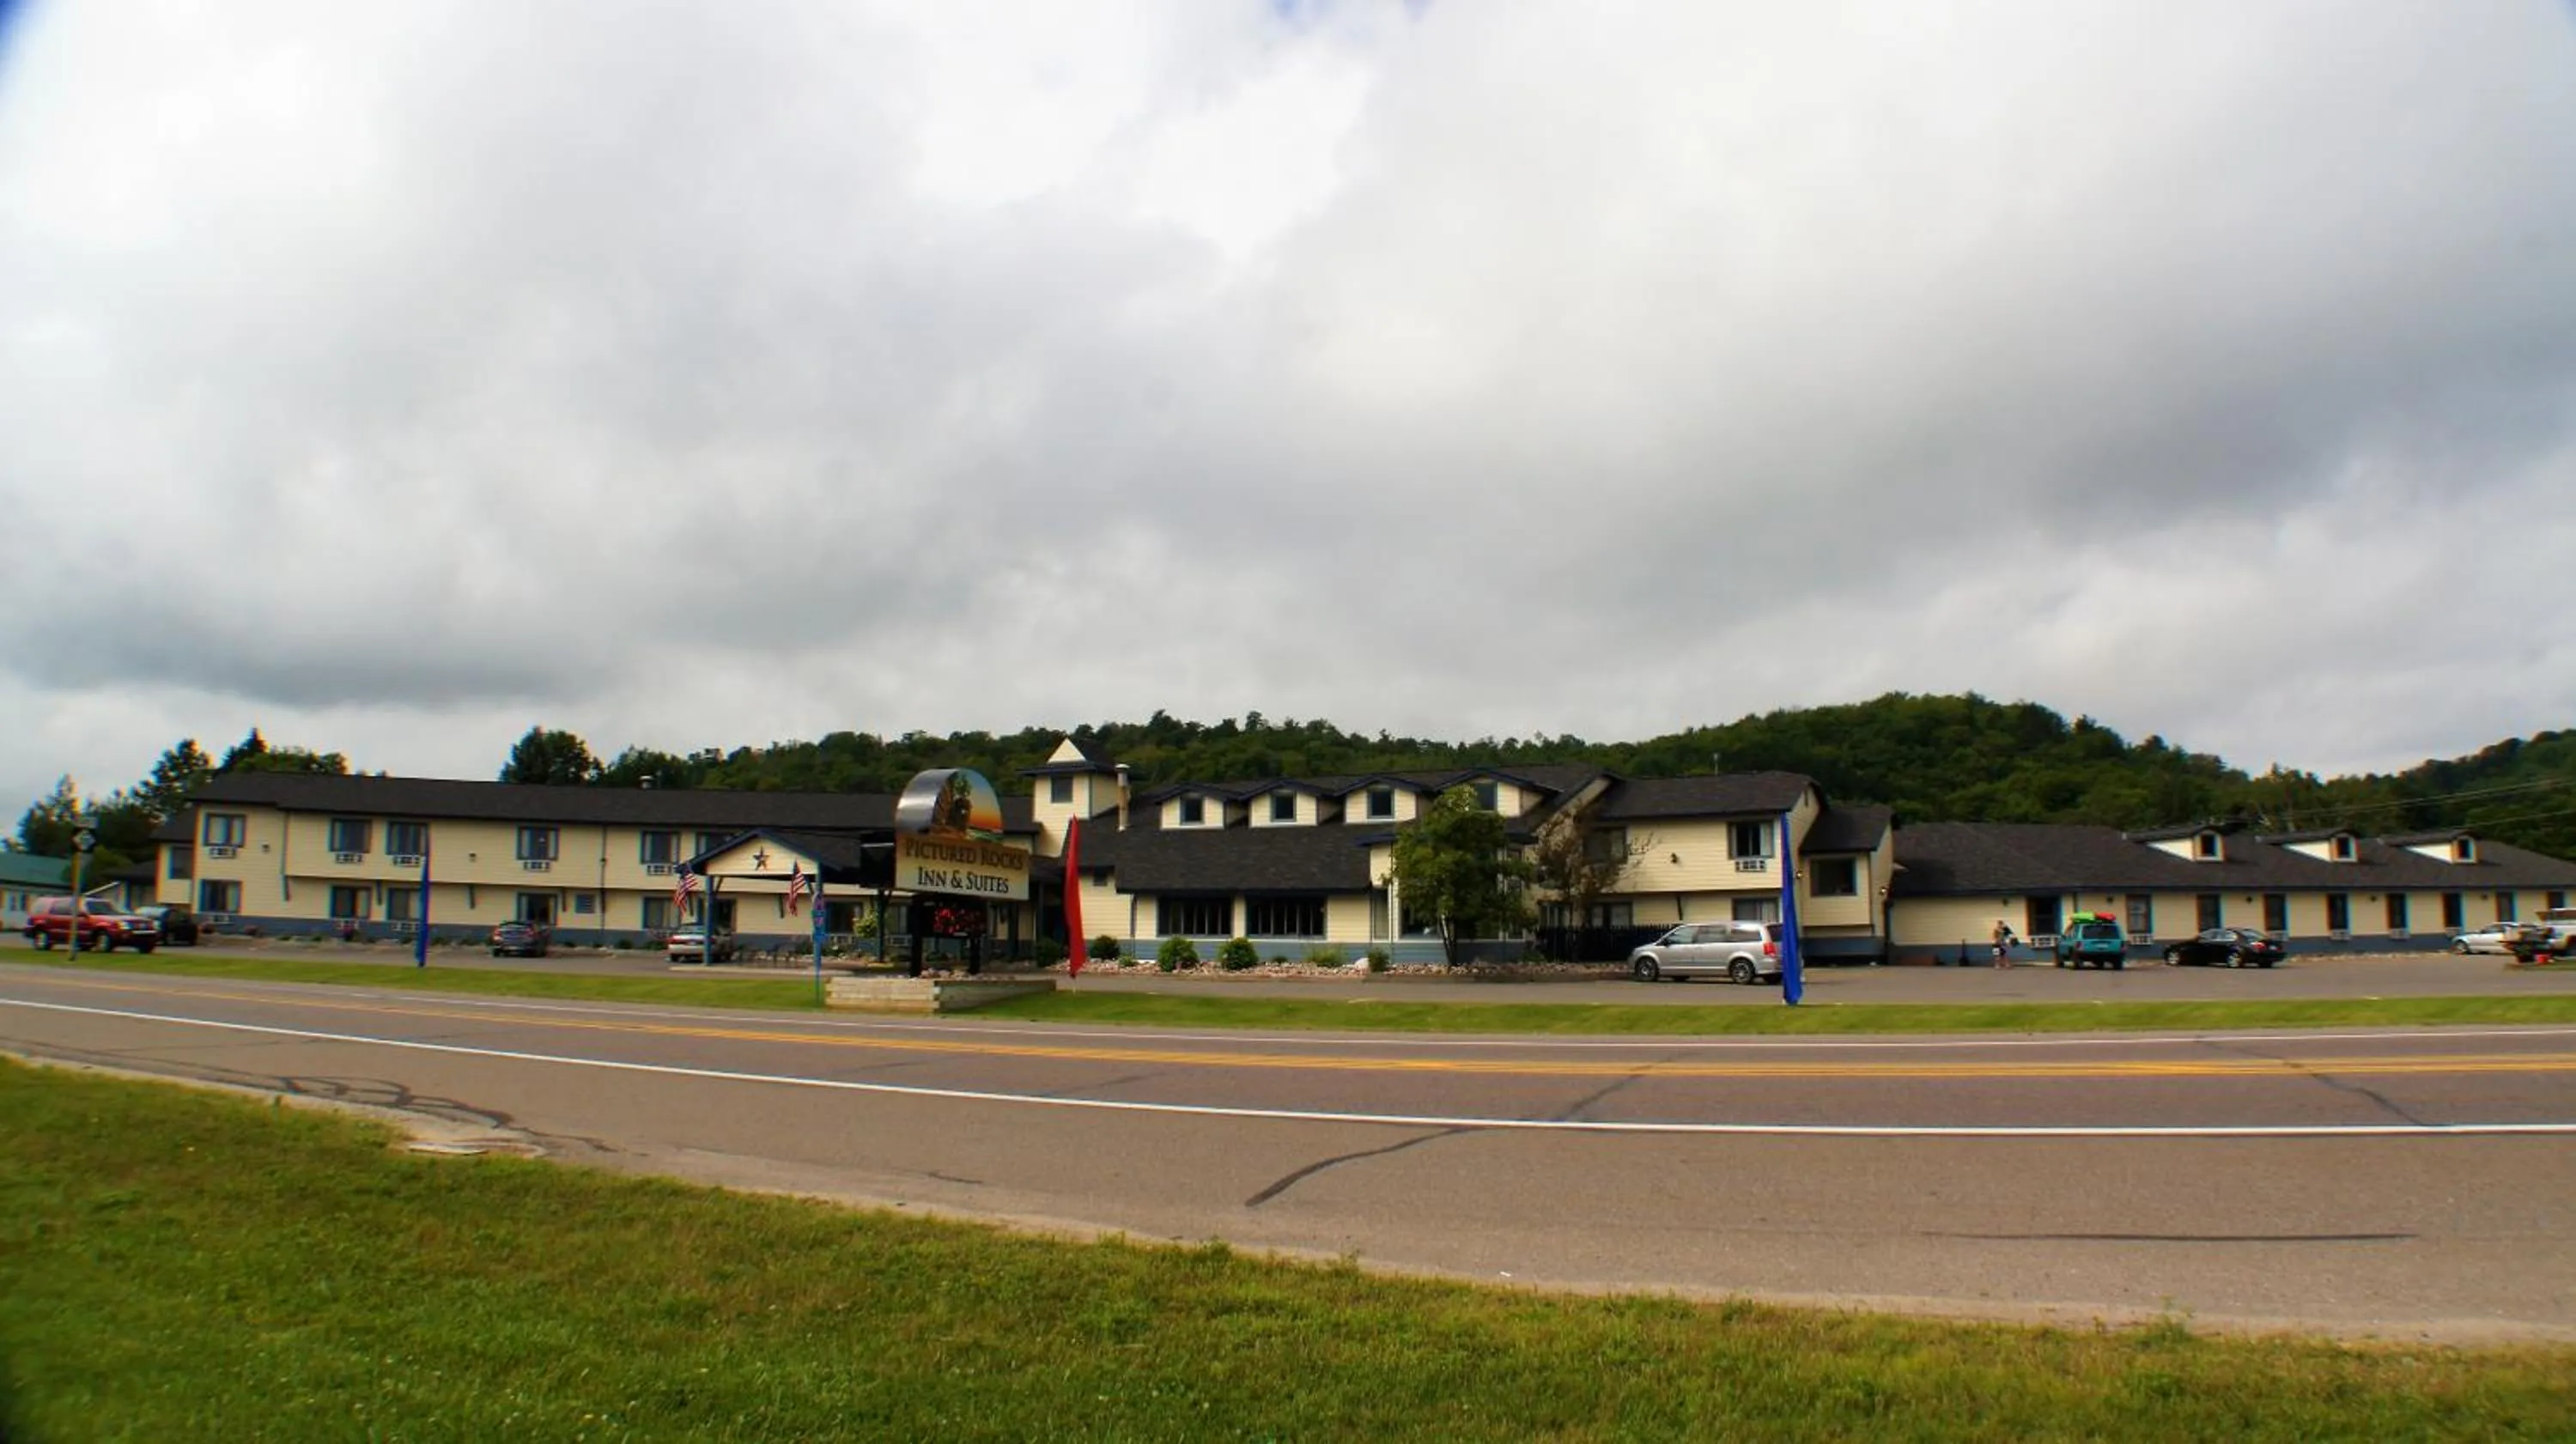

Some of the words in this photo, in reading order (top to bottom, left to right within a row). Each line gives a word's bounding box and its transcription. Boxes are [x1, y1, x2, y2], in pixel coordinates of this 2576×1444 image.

[906, 837, 976, 864] PICTURED
[981, 846, 1024, 871] ROCKS
[918, 865, 946, 886] INN
[951, 870, 963, 889] &
[967, 871, 1009, 894] SUITES
